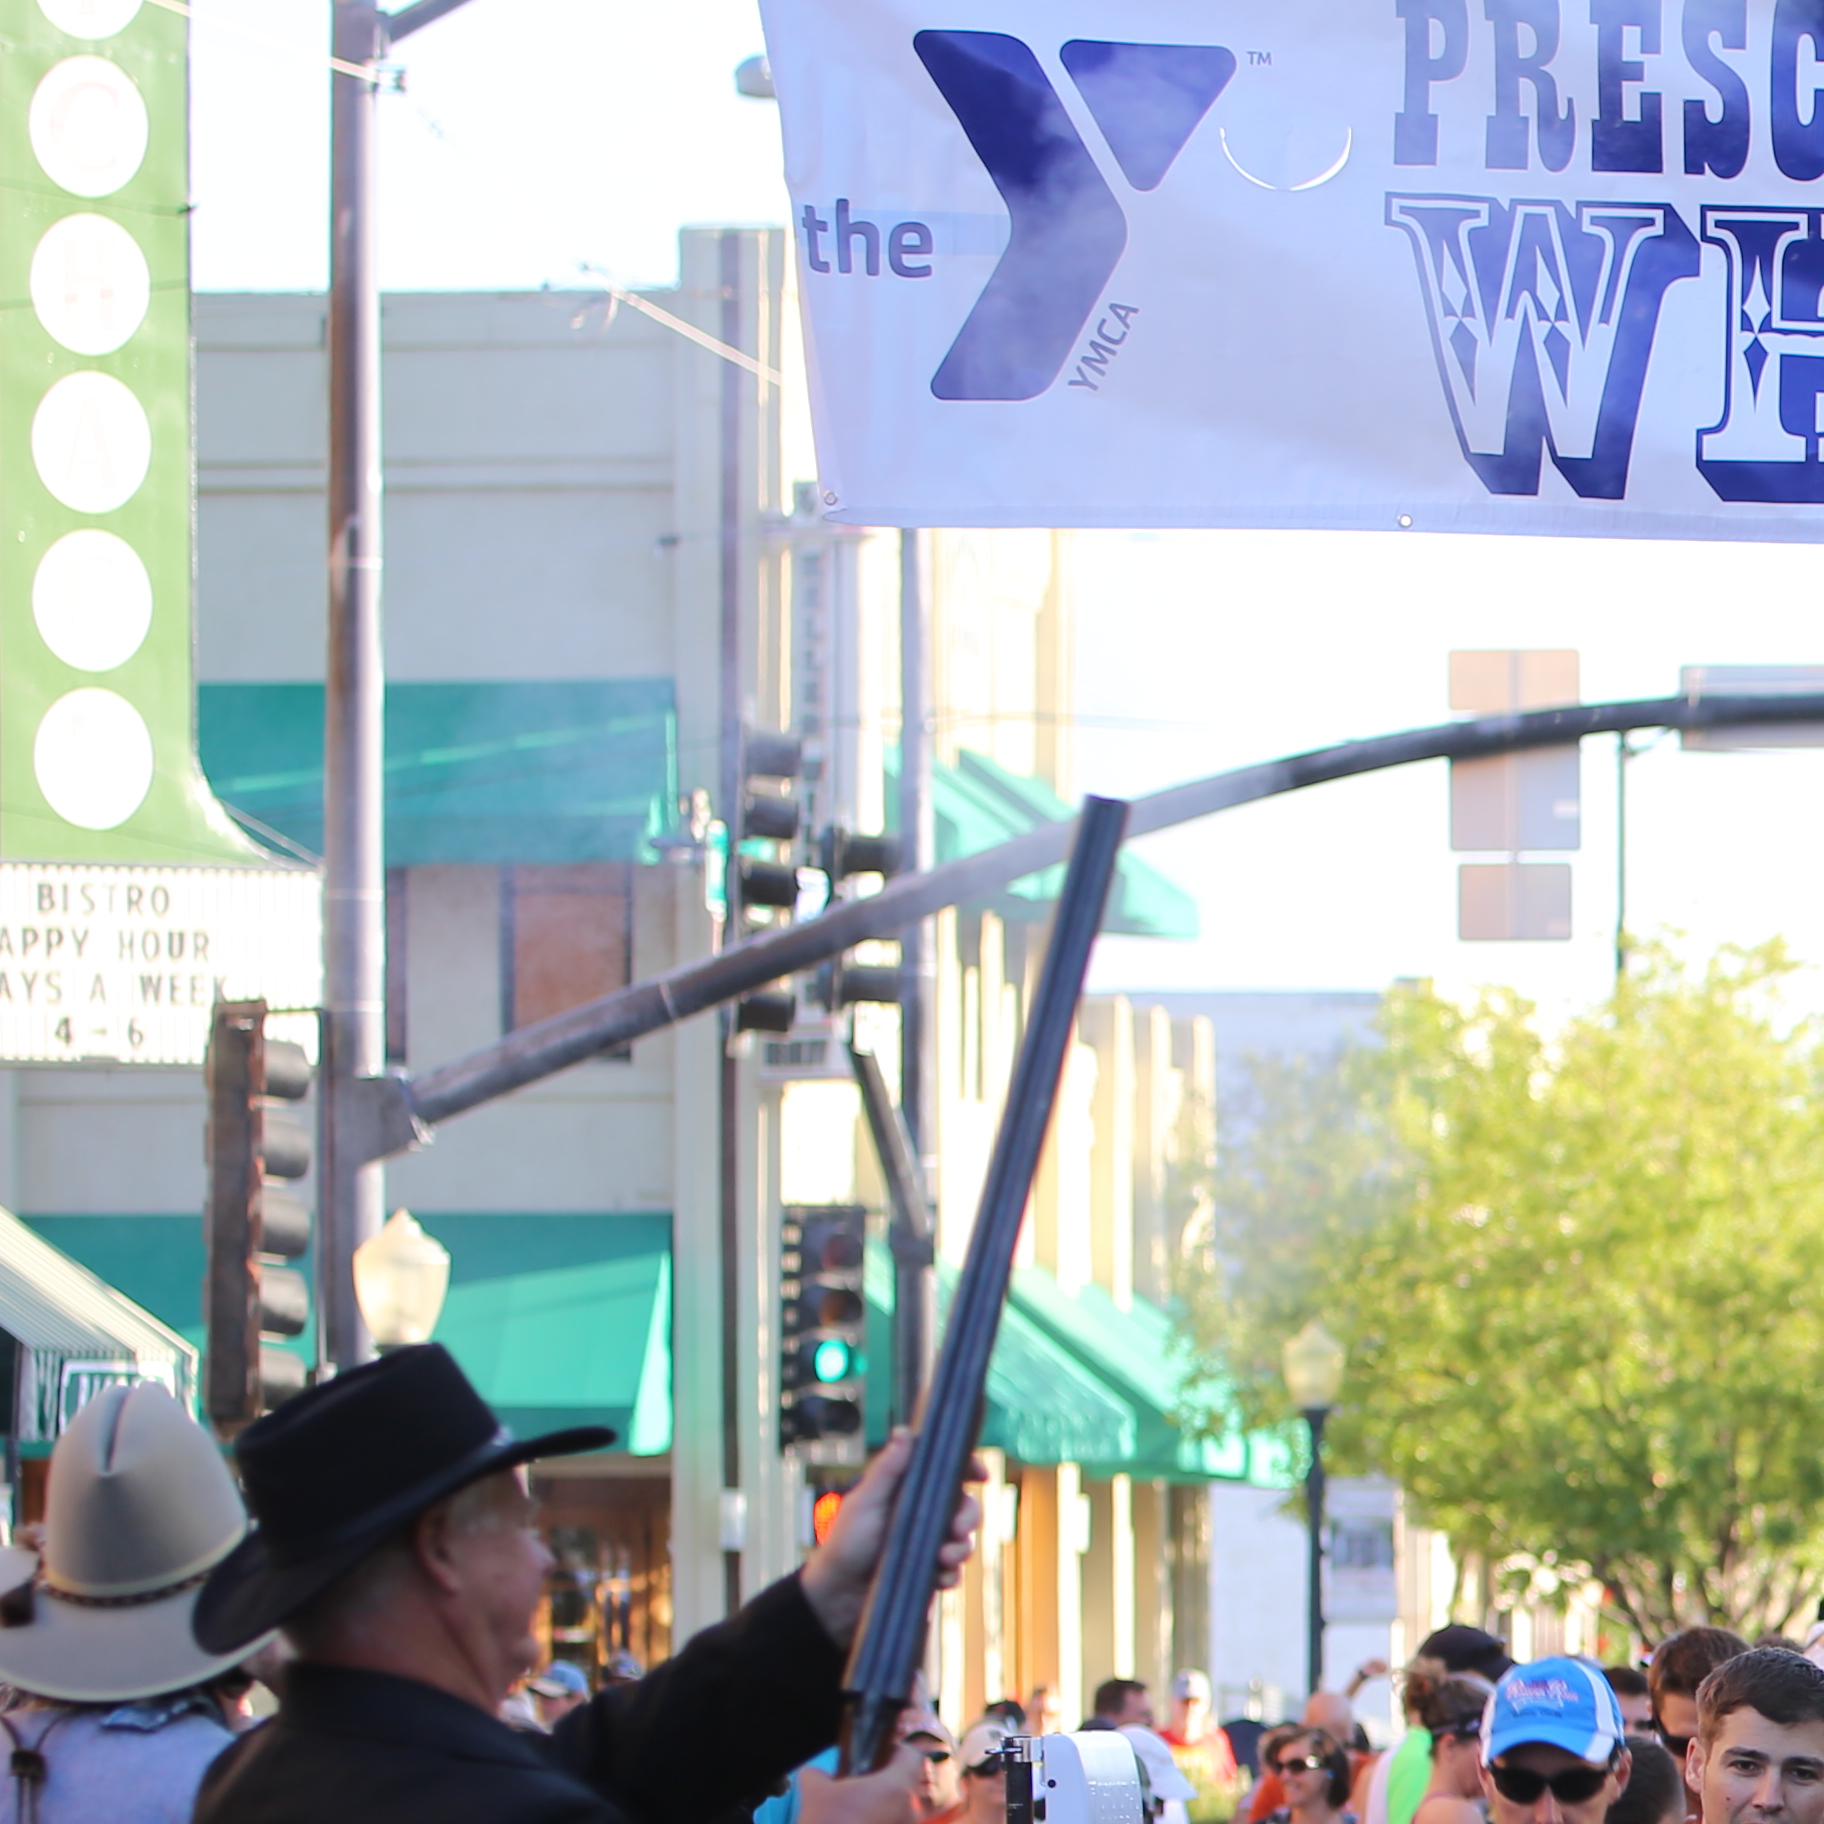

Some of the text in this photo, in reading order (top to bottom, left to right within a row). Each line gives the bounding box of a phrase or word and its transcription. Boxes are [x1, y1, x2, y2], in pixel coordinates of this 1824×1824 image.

[803, 199, 933, 279] the
[1068, 300, 1139, 394] YMCA
[37, 882, 171, 917] BISTRO
[118, 930, 210, 961] HOUR
[89, 974, 107, 1001] A
[54, 1017, 72, 1044] 4
[128, 1017, 144, 1046] 6
